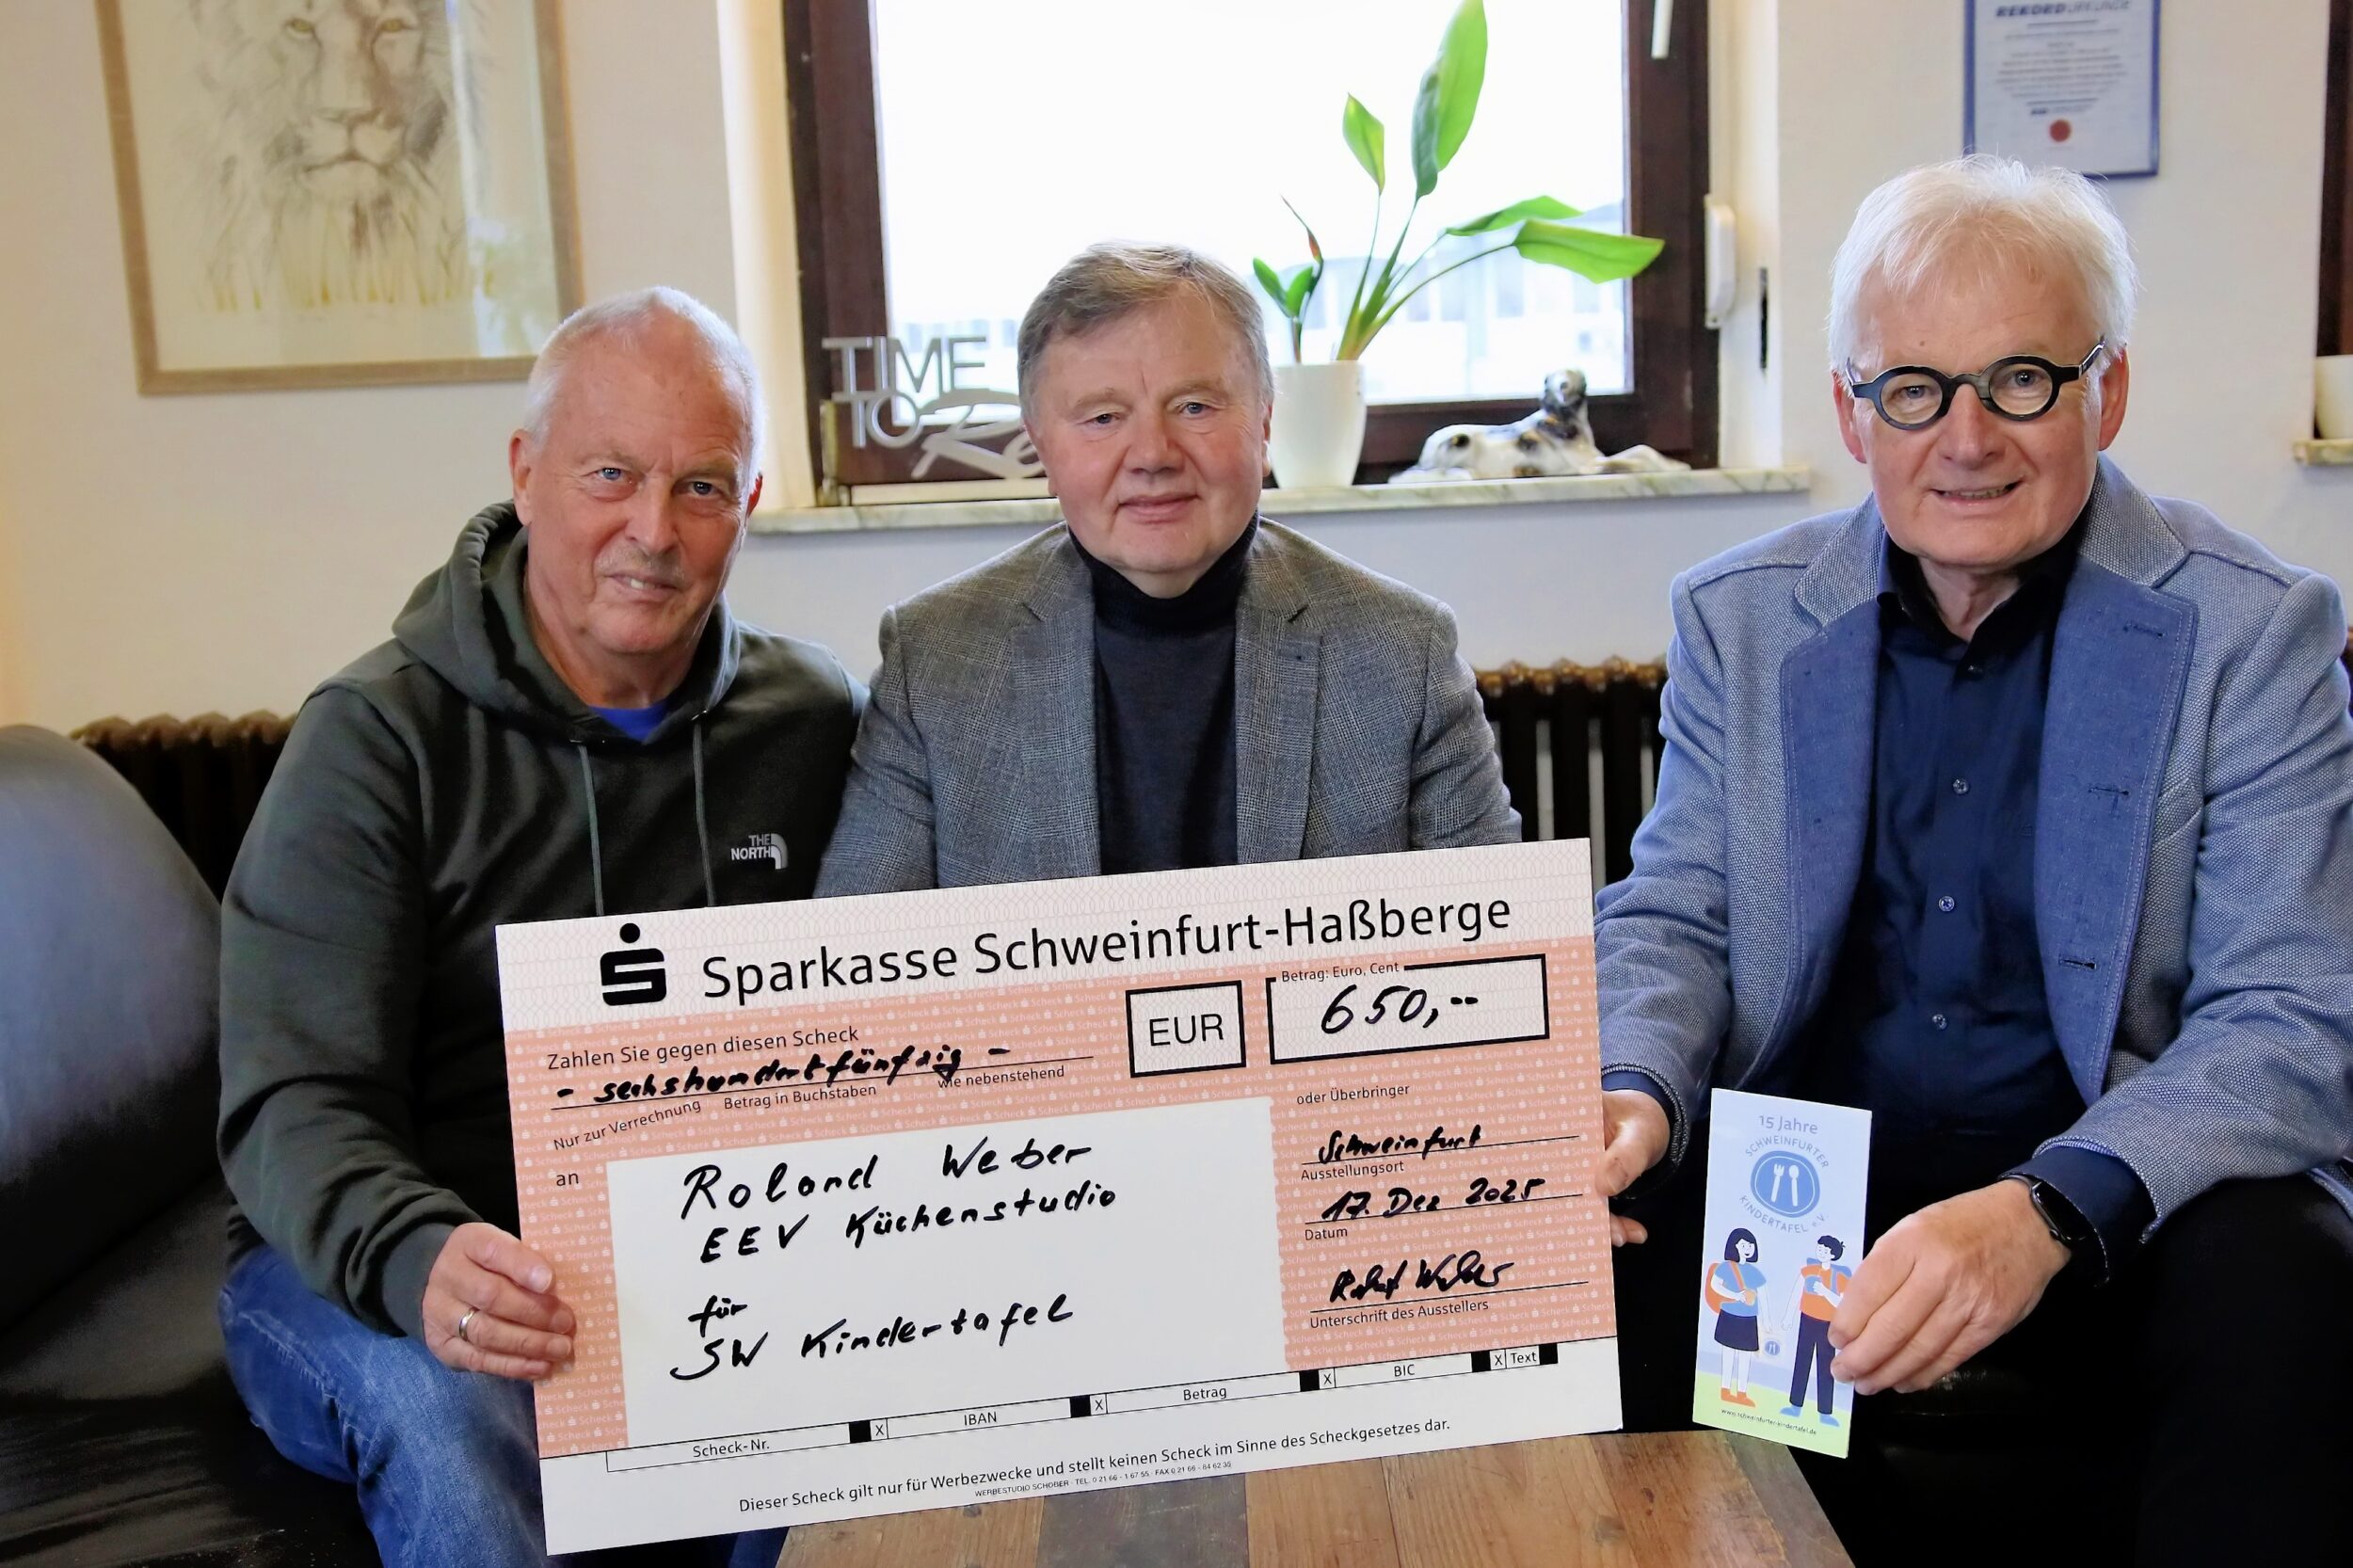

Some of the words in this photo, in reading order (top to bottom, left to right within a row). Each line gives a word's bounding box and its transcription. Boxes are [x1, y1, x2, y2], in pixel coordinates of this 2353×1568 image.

[822, 336, 986, 393] TIME
[831, 390, 920, 449] TO
[730, 846, 771, 861] NORTH
[748, 833, 770, 846] THE
[702, 945, 957, 1006] Sparkasse
[973, 897, 1513, 974] Schweinfurt-Haßberge
[1281, 963, 1330, 984] Betrag:
[1332, 963, 1367, 979] Euro,
[1369, 961, 1401, 975] Cent
[1147, 1013, 1225, 1048] EUR
[546, 1049, 615, 1071] Zahlen
[619, 1045, 650, 1064] Sie
[656, 1042, 717, 1064] gegen
[723, 1035, 788, 1054] diesen
[792, 1025, 859, 1048] Scheck
[966, 1064, 1065, 1088] nebenstehend
[724, 1096, 772, 1112] Betrag
[775, 1092, 789, 1105] in
[793, 1084, 877, 1103] Buchstaben
[1296, 1091, 1327, 1106] oder
[1329, 1084, 1411, 1102] Überbringer
[553, 1135, 580, 1151] Nur
[583, 1128, 606, 1143] zur
[608, 1099, 702, 1134] Verrechnung
[1758, 1114, 1775, 1129] 15
[1777, 1115, 1818, 1135] Jahre
[1744, 1134, 1830, 1169] SCHWEINFURTER
[555, 1172, 580, 1187] an
[680, 1153, 879, 1221] Roland
[940, 1135, 1094, 1179] Weber
[1301, 1160, 1405, 1182] Ausstellungsort
[1465, 1176, 1545, 1205] 2025
[844, 1178, 1117, 1250] Küchenstudio
[1738, 1194, 1809, 1234] KINDERTAFEL
[1304, 1226, 1349, 1241] Datum
[687, 1293, 749, 1340] für
[1309, 1307, 1389, 1330] Unterschrift
[1391, 1305, 1415, 1320] des
[1417, 1299, 1490, 1319] Ausstellers
[668, 1331, 769, 1382] SW
[799, 1291, 1075, 1360] Kindertafel
[1393, 1363, 1416, 1378] BIC
[1510, 1349, 1538, 1365] Text
[1182, 1385, 1228, 1403] Betrag
[962, 1411, 999, 1427] IBAN
[692, 1436, 772, 1459] Scheck-Nr.
[739, 1495, 789, 1512] Dieser
[792, 1485, 845, 1507] Scheck
[848, 1483, 874, 1503] gilt
[877, 1481, 904, 1496] nur
[905, 1478, 929, 1493] für
[930, 1464, 1033, 1489] Werbezwecke
[1036, 1460, 1064, 1477] und
[1068, 1455, 1106, 1473] stellt
[1109, 1452, 1158, 1468] keinen
[1160, 1443, 1212, 1464] Scheck
[1214, 1441, 1234, 1457] im
[1236, 1437, 1278, 1454] Sinne
[1280, 1433, 1306, 1449] des
[1308, 1419, 1422, 1447] Scheckgesetzes
[1424, 1417, 1451, 1432] dar.
[974, 1484, 1031, 1497] WERBESTUDIO
[1032, 1479, 1069, 1491] SCHOBER
[1155, 1467, 1170, 1477] FAX
